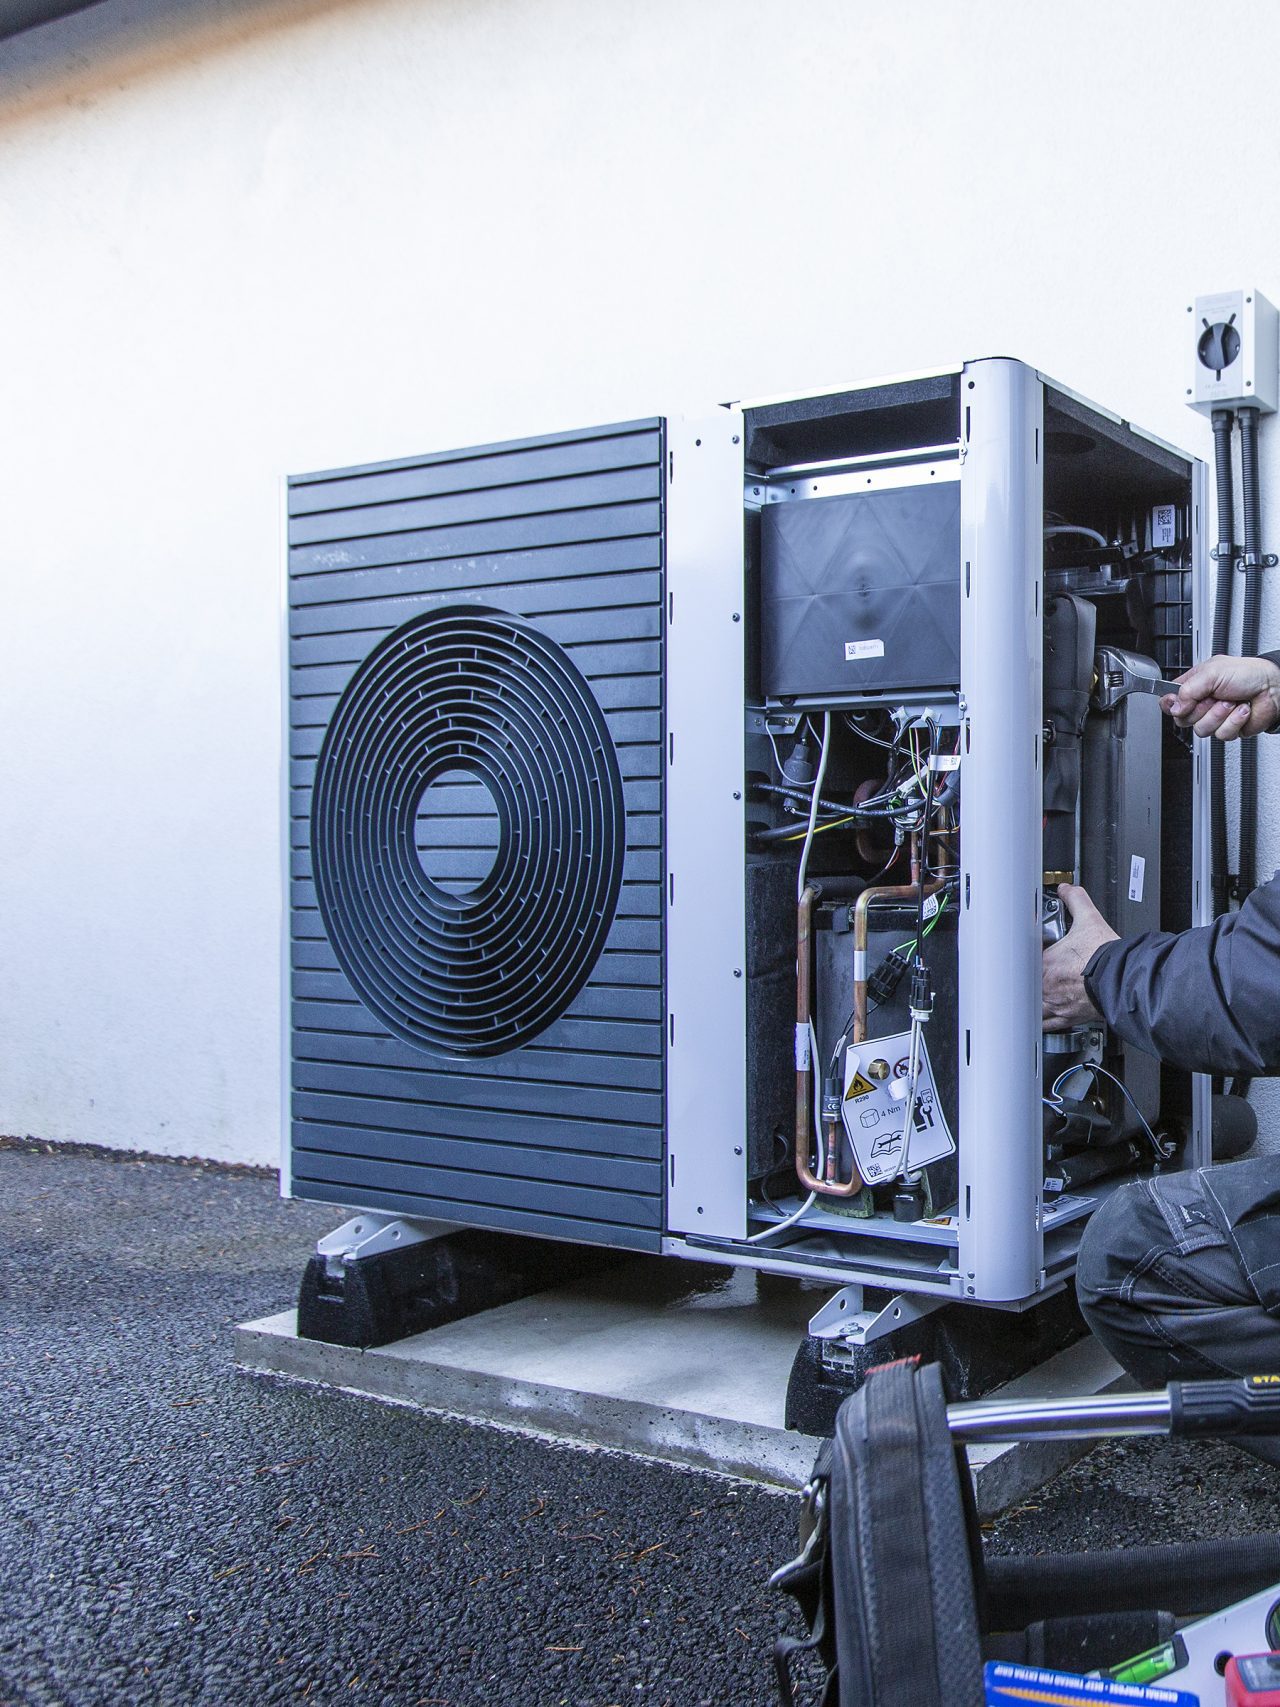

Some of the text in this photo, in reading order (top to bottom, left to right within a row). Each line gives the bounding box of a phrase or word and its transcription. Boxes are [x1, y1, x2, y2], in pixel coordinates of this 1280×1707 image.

[855, 1095, 870, 1104] R290
[887, 1106, 901, 1115] Nm
[994, 1664, 1178, 1703] GENERAL PURPOSE DEEP THREAD FOR EXTRA GRIP
